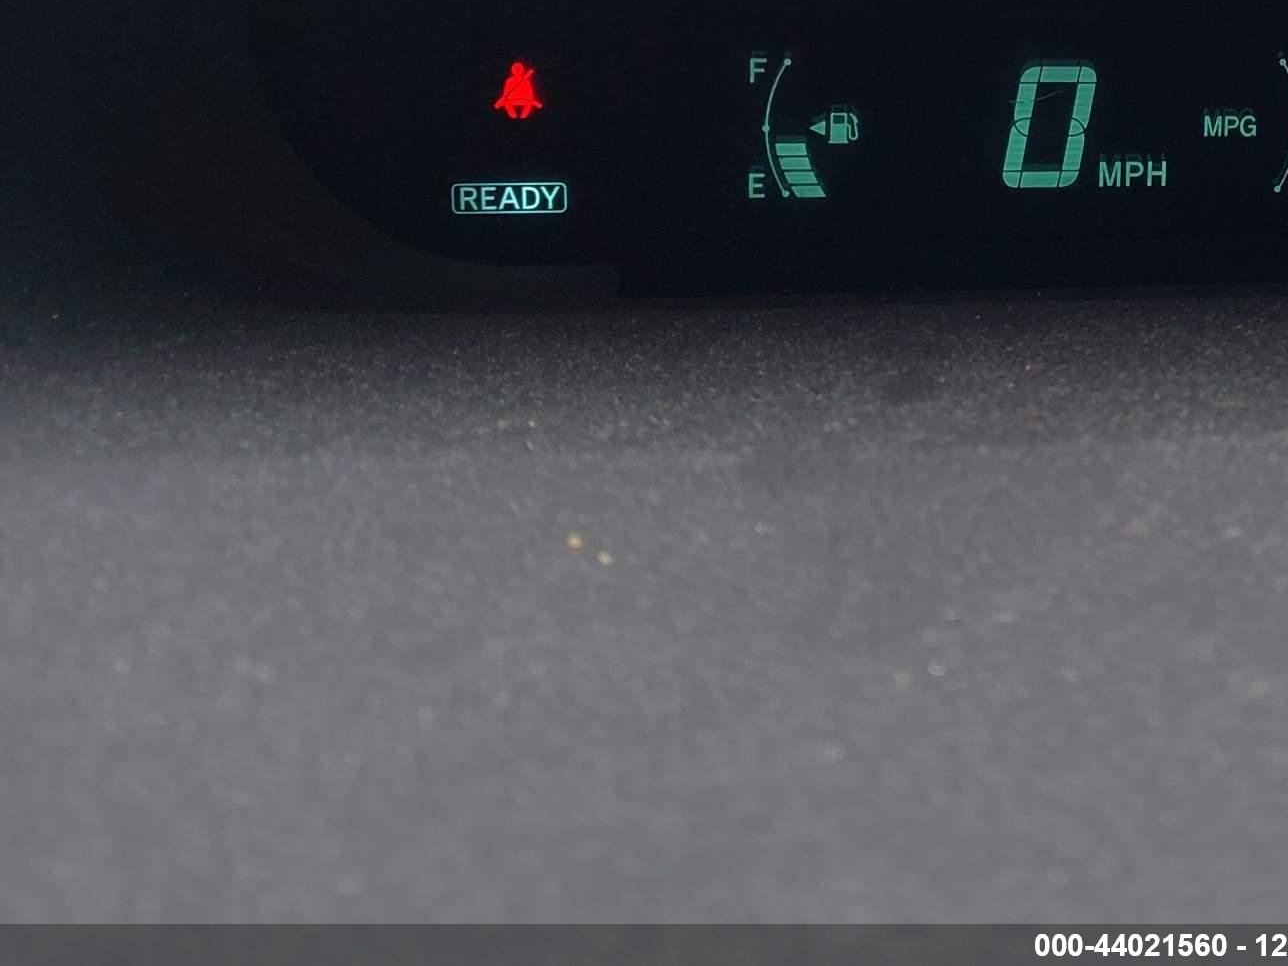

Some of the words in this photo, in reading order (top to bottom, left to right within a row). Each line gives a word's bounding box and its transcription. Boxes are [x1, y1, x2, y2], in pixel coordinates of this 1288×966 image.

[749, 57, 768, 84] F
[1002, 65, 1098, 189] 0
[1203, 115, 1257, 138] MPG
[748, 172, 766, 199] E
[1099, 160, 1167, 188] MPH
[458, 186, 561, 211] READY
